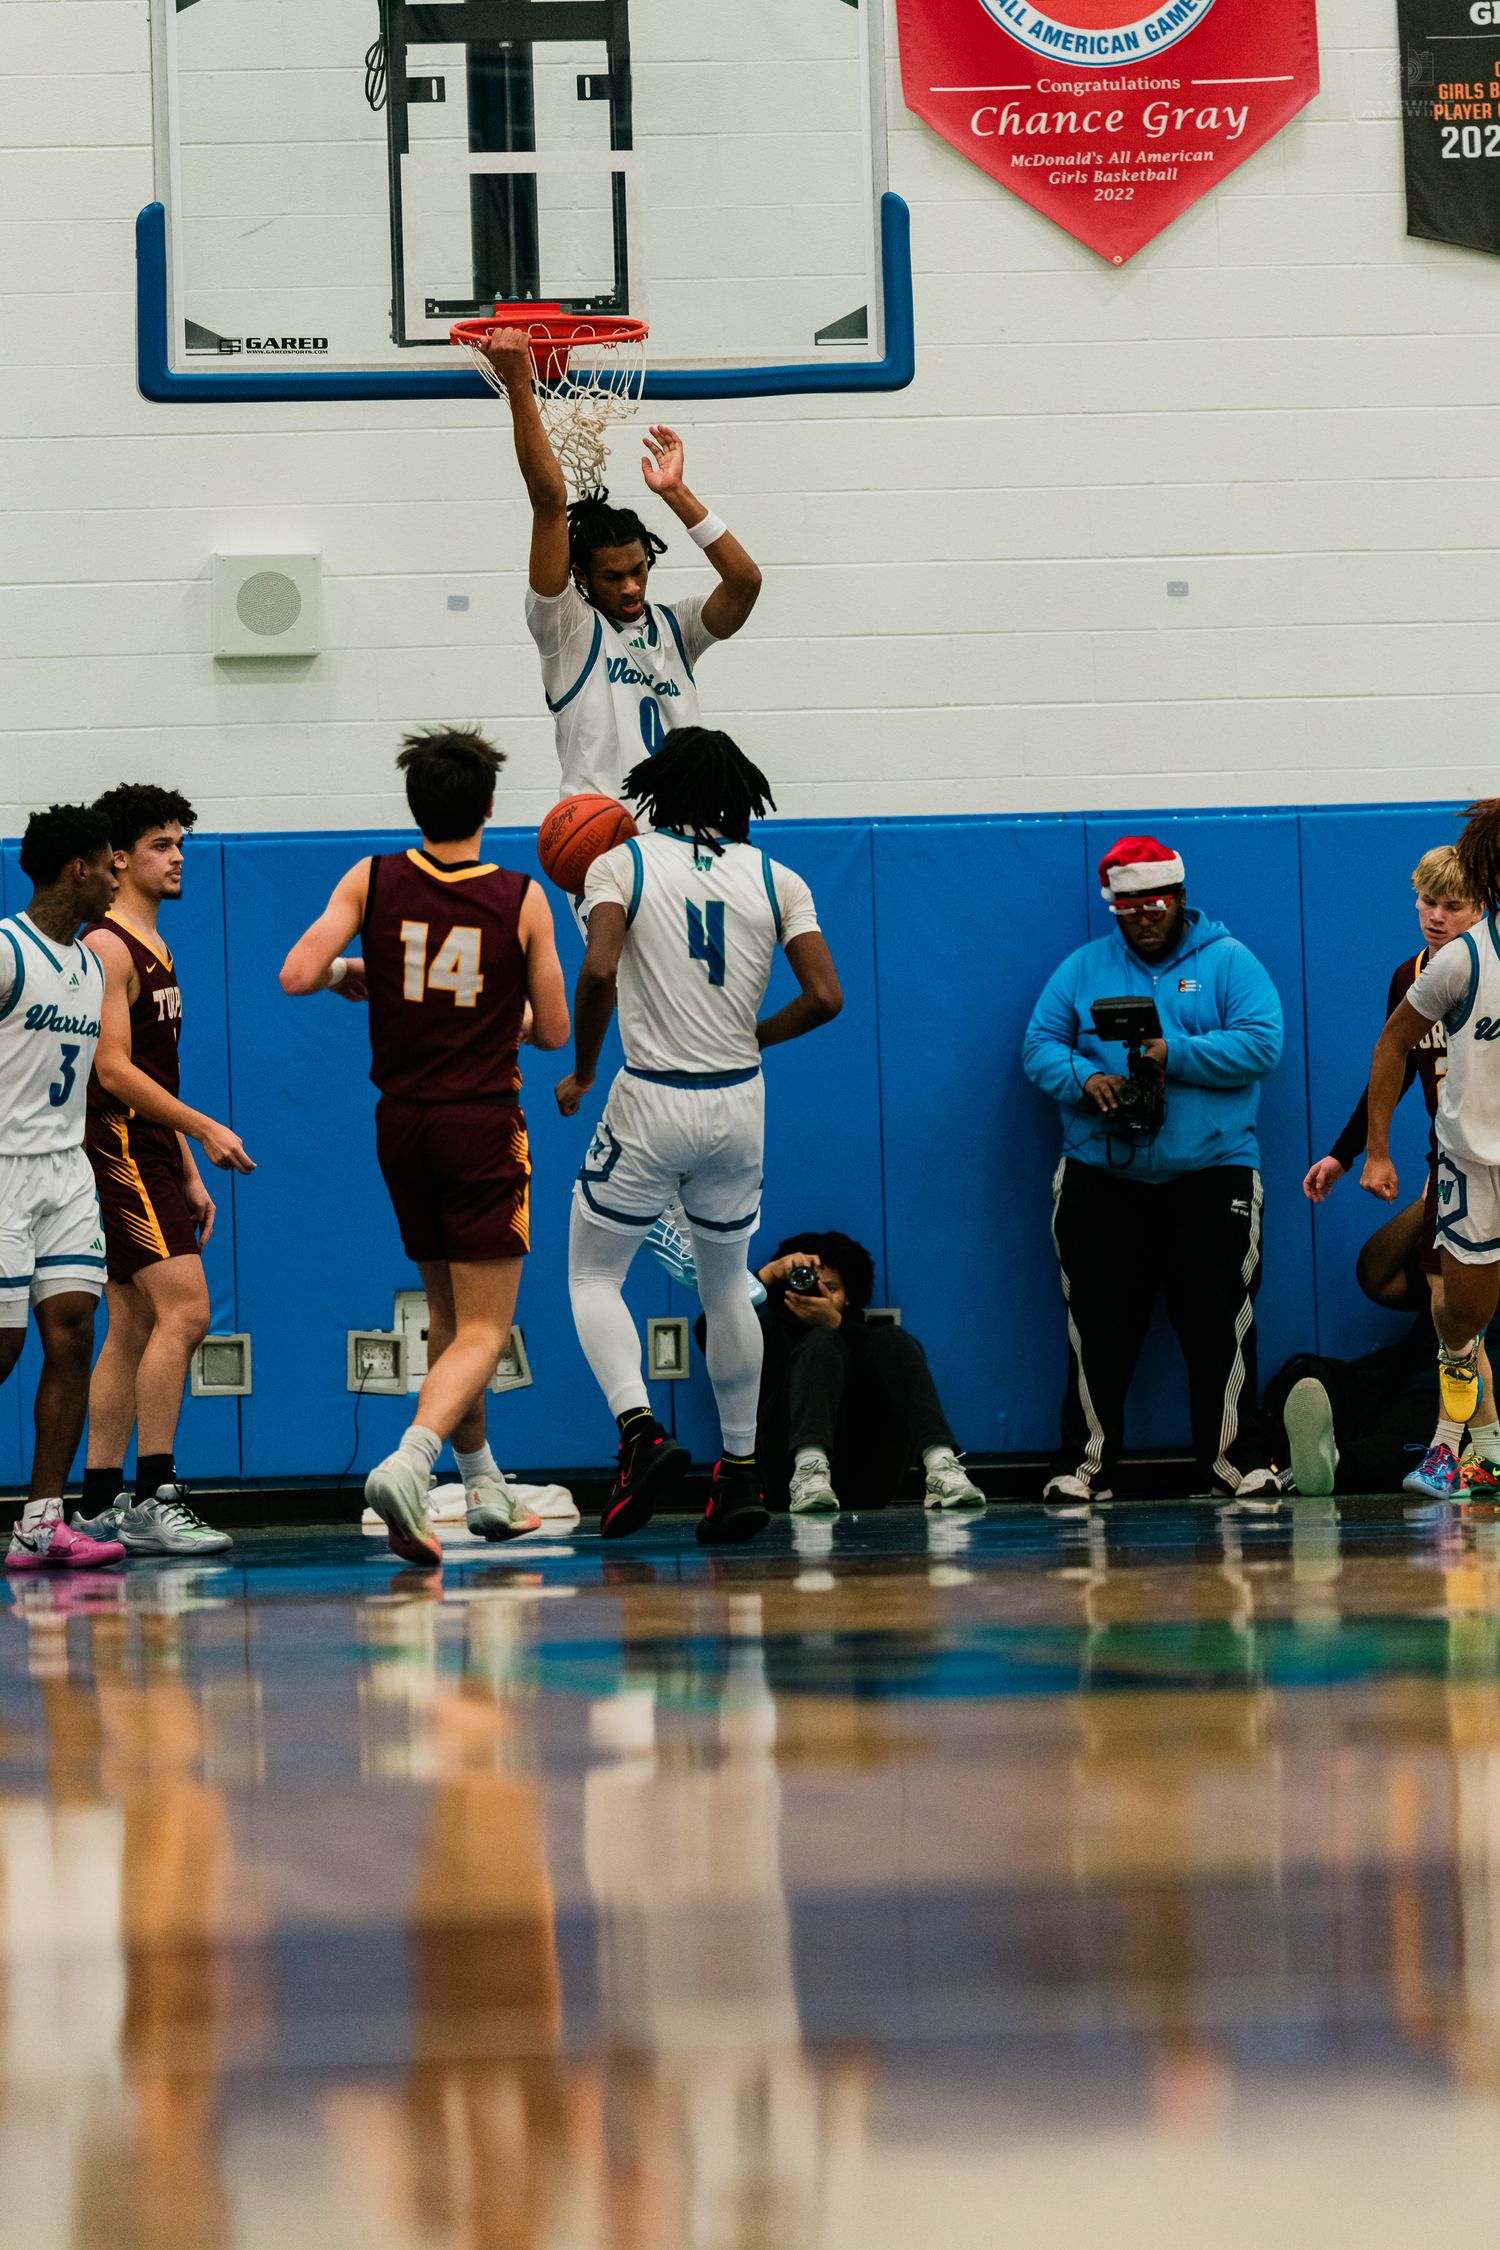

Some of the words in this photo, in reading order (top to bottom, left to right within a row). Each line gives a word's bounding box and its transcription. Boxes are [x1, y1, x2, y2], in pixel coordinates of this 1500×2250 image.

[1028, 19, 1140, 55] AMERICAN
[1144, 0, 1203, 42] GAME
[1036, 76, 1181, 96] Congratulations
[1438, 82, 1485, 100] GIRLS
[970, 101, 1125, 137] Chance
[1142, 101, 1249, 140] Gray
[1434, 102, 1492, 121] PLAYER
[1010, 151, 1104, 168] McDonald's
[1108, 150, 1131, 165] All
[1135, 149, 1214, 164] American
[1048, 170, 1088, 185] Girls
[1093, 167, 1178, 183] Basketball
[1093, 187, 1135, 201] 2022
[245, 337, 328, 349] GARED
[639, 696, 666, 758] 0
[685, 896, 725, 987] 4
[400, 919, 484, 1007] 14
[49, 1043, 81, 1108] 3
